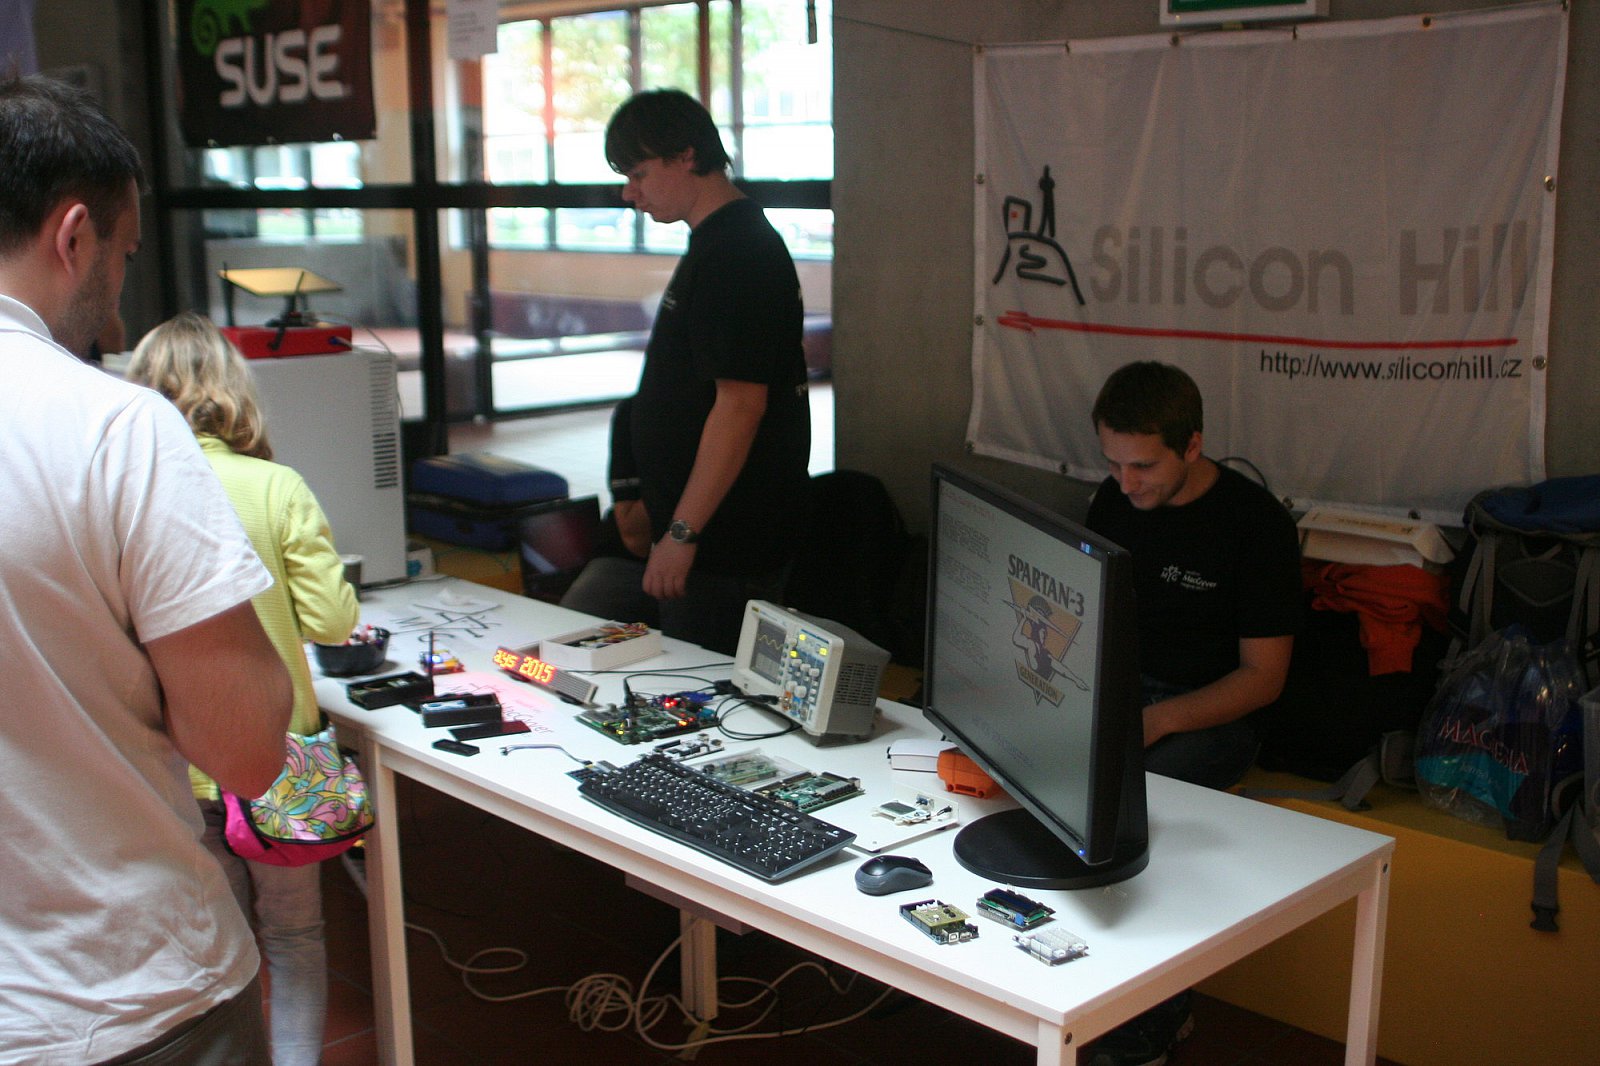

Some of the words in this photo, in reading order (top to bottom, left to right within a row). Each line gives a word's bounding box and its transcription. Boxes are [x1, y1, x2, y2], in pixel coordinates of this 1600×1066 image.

[214, 24, 344, 108] SUSE
[1089, 224, 1353, 315] Silicon
[1400, 220, 1528, 316] Hill
[1260, 350, 1522, 379] http://www.siliconhill.cz
[1007, 553, 1085, 617] SPARTAN-3
[519, 655, 556, 683] 2015
